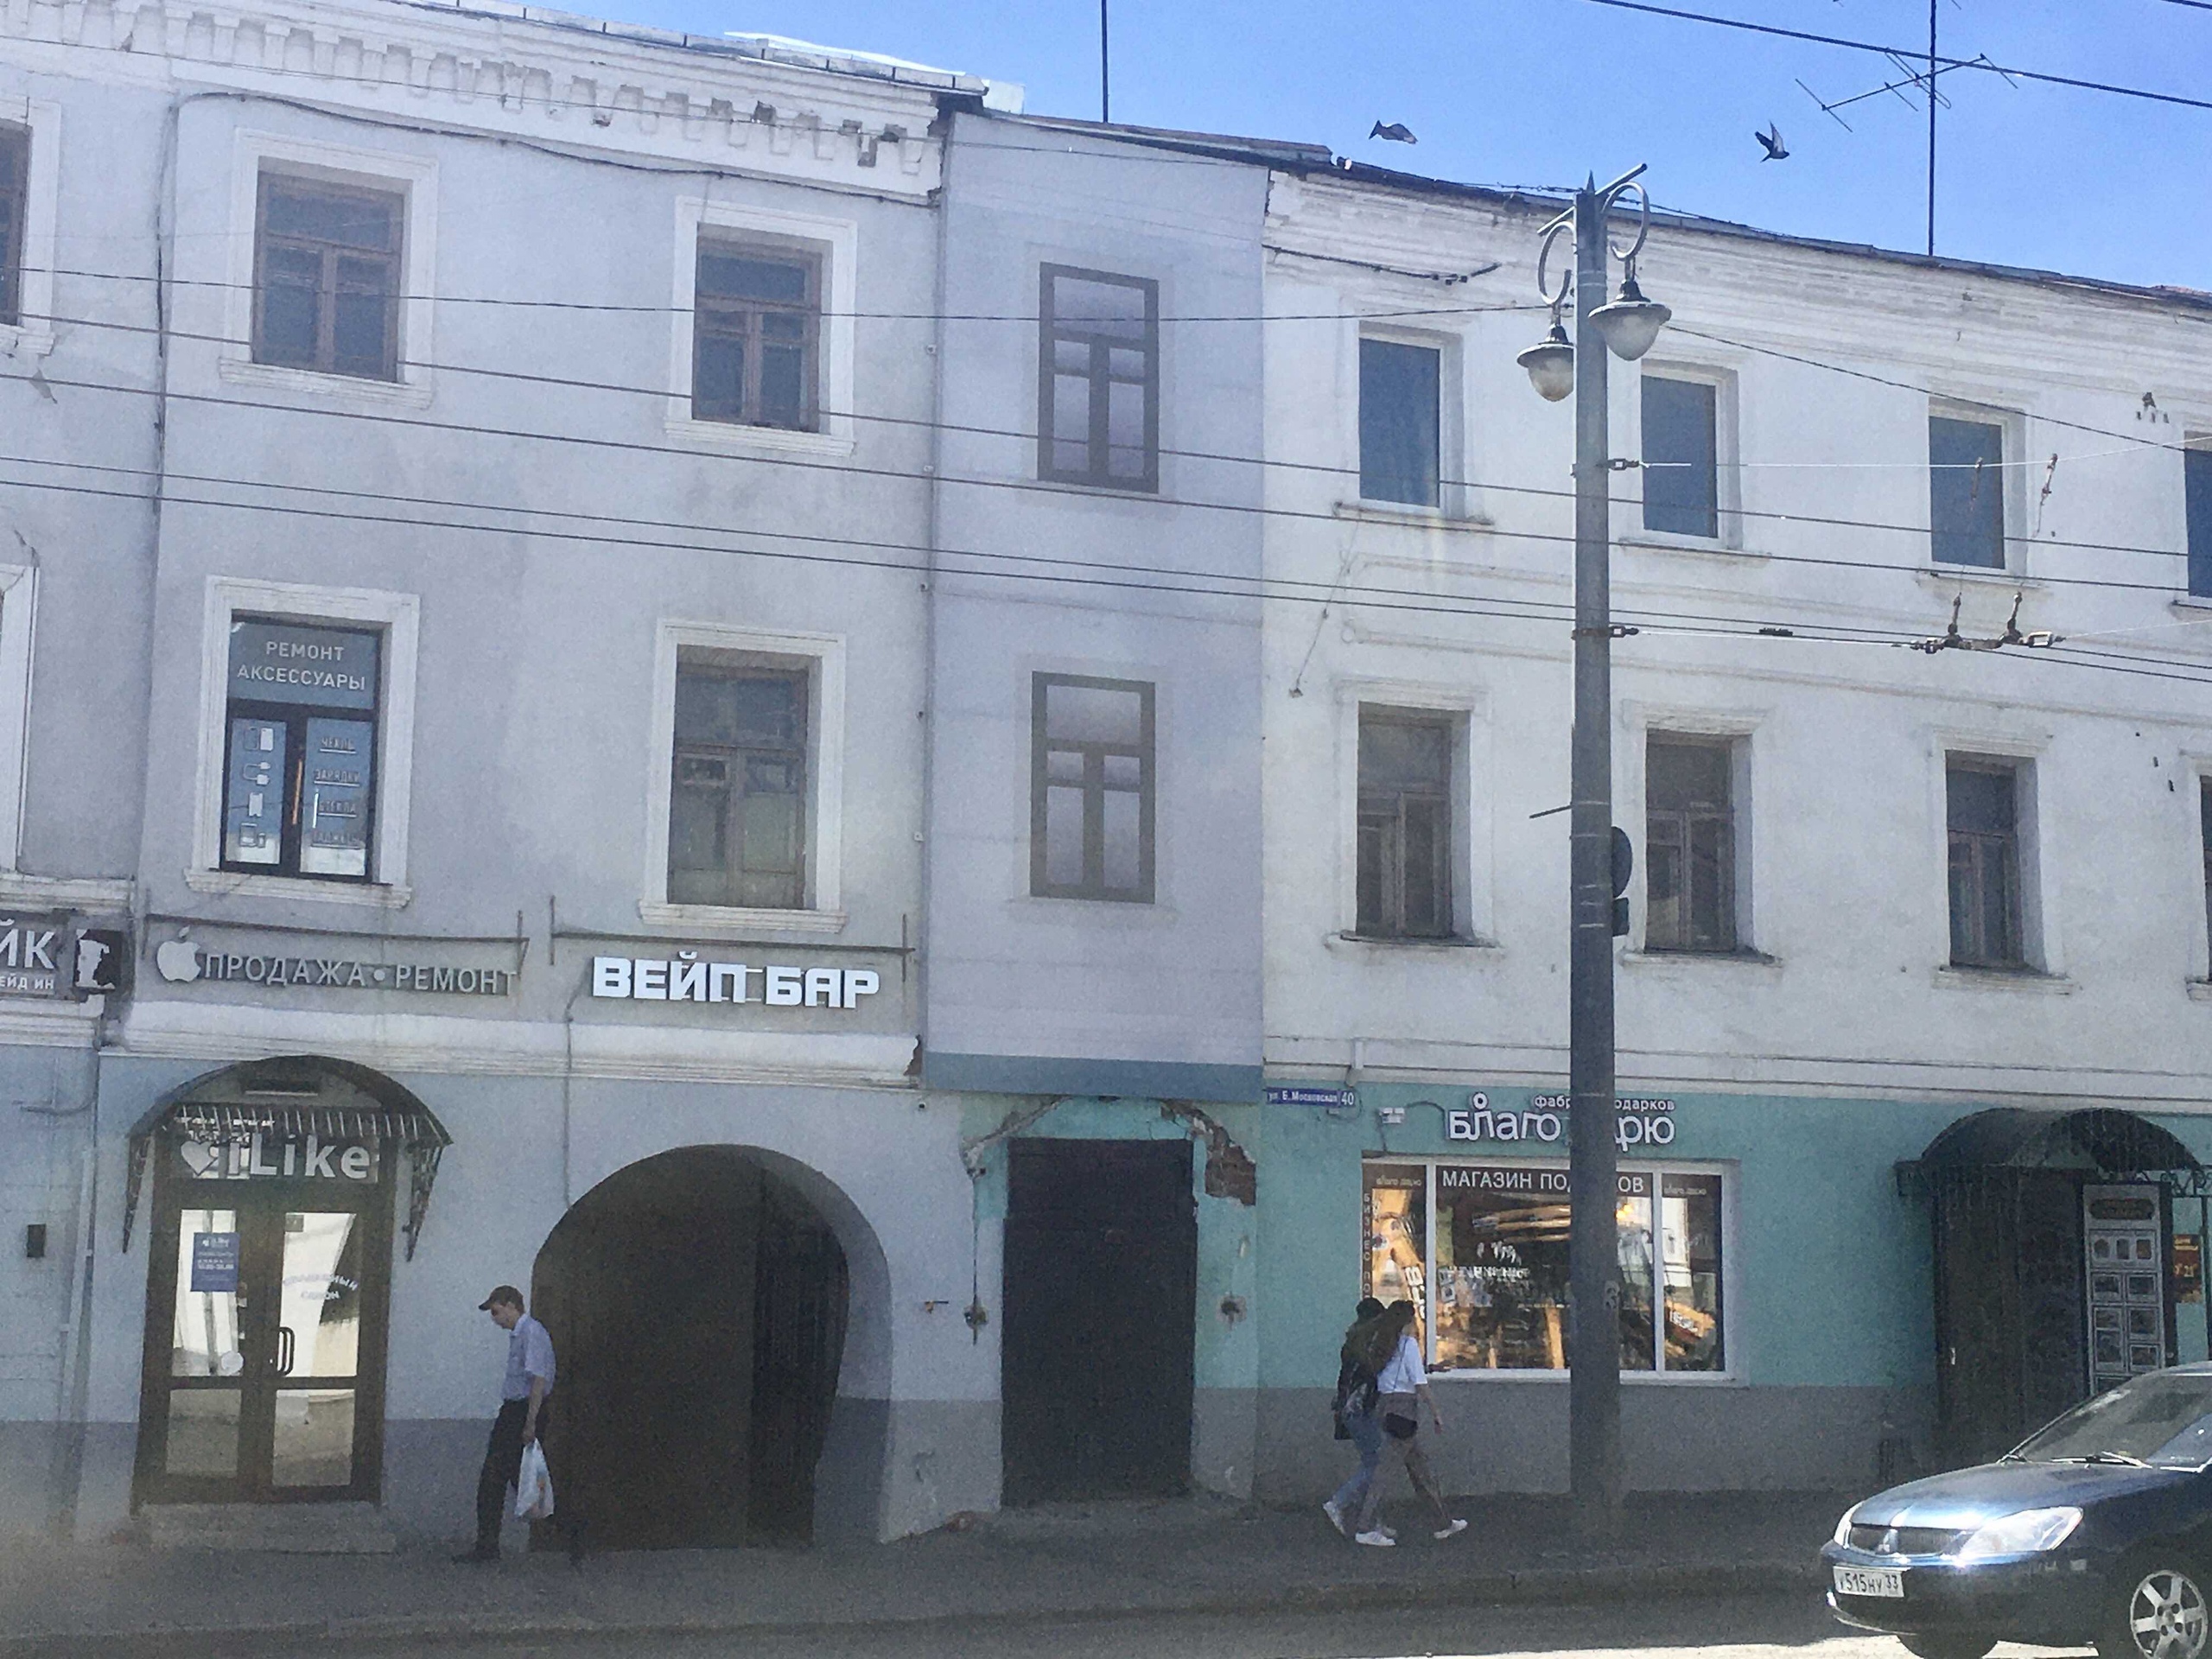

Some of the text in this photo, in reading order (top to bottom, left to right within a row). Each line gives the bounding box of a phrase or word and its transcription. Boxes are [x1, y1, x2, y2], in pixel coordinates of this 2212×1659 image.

[265, 640, 345, 662] РЕМОНТ
[237, 664, 366, 691] АКСЕССУАРЫ
[35, 978, 54, 990] ИН
[204, 953, 518, 996] ПРОДАЖА РЕМОНТ
[592, 950, 880, 1009] ВЕЙП БАР
[1340, 1091, 1355, 1106] 40
[1609, 1098, 1675, 1112] одарков
[228, 1132, 370, 1180] iLike
[1442, 1169, 1532, 1190] МАГАЗИН
